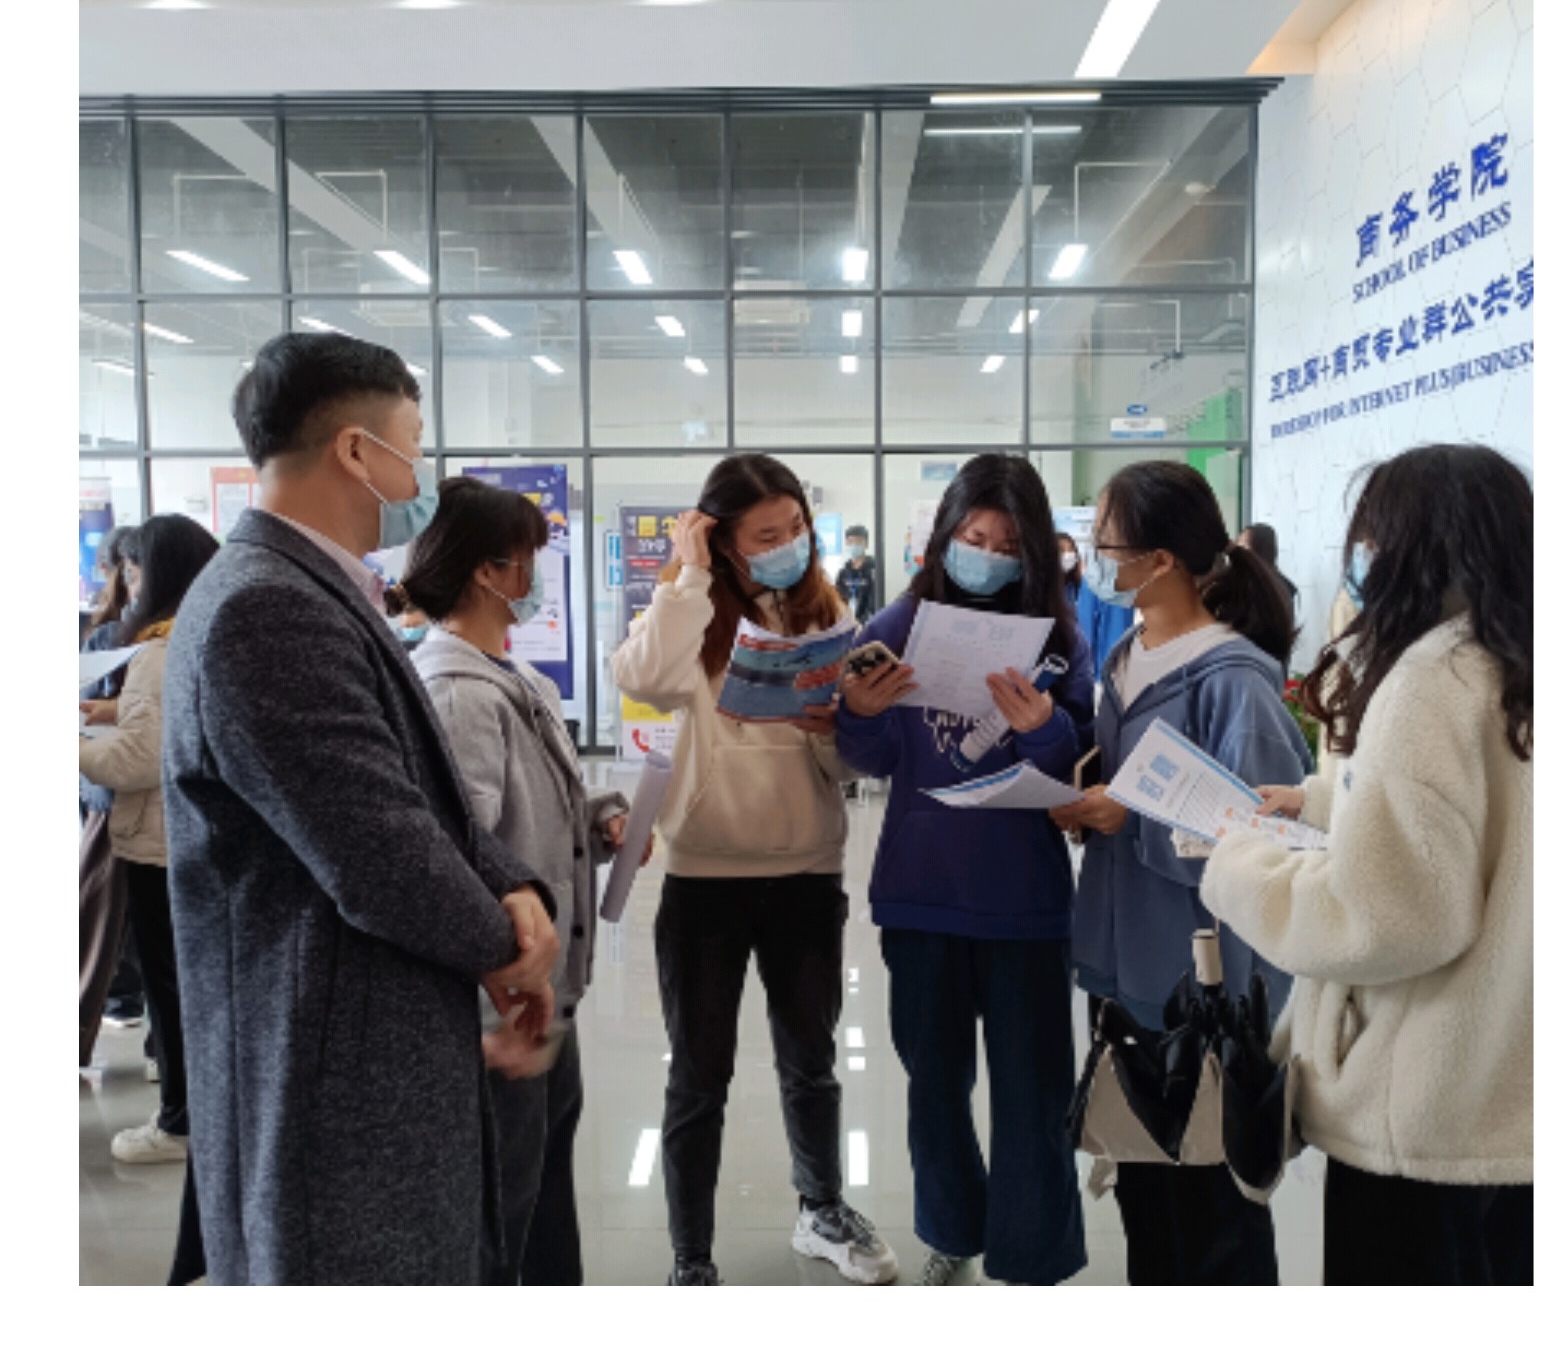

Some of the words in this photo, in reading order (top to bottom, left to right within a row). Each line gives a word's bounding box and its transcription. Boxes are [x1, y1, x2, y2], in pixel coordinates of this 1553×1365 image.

[1352, 258, 1406, 304] SCHOOL
[1408, 243, 1430, 273] OF
[1430, 200, 1512, 263] BUSINESS
[1355, 132, 1509, 268] 商务学院
